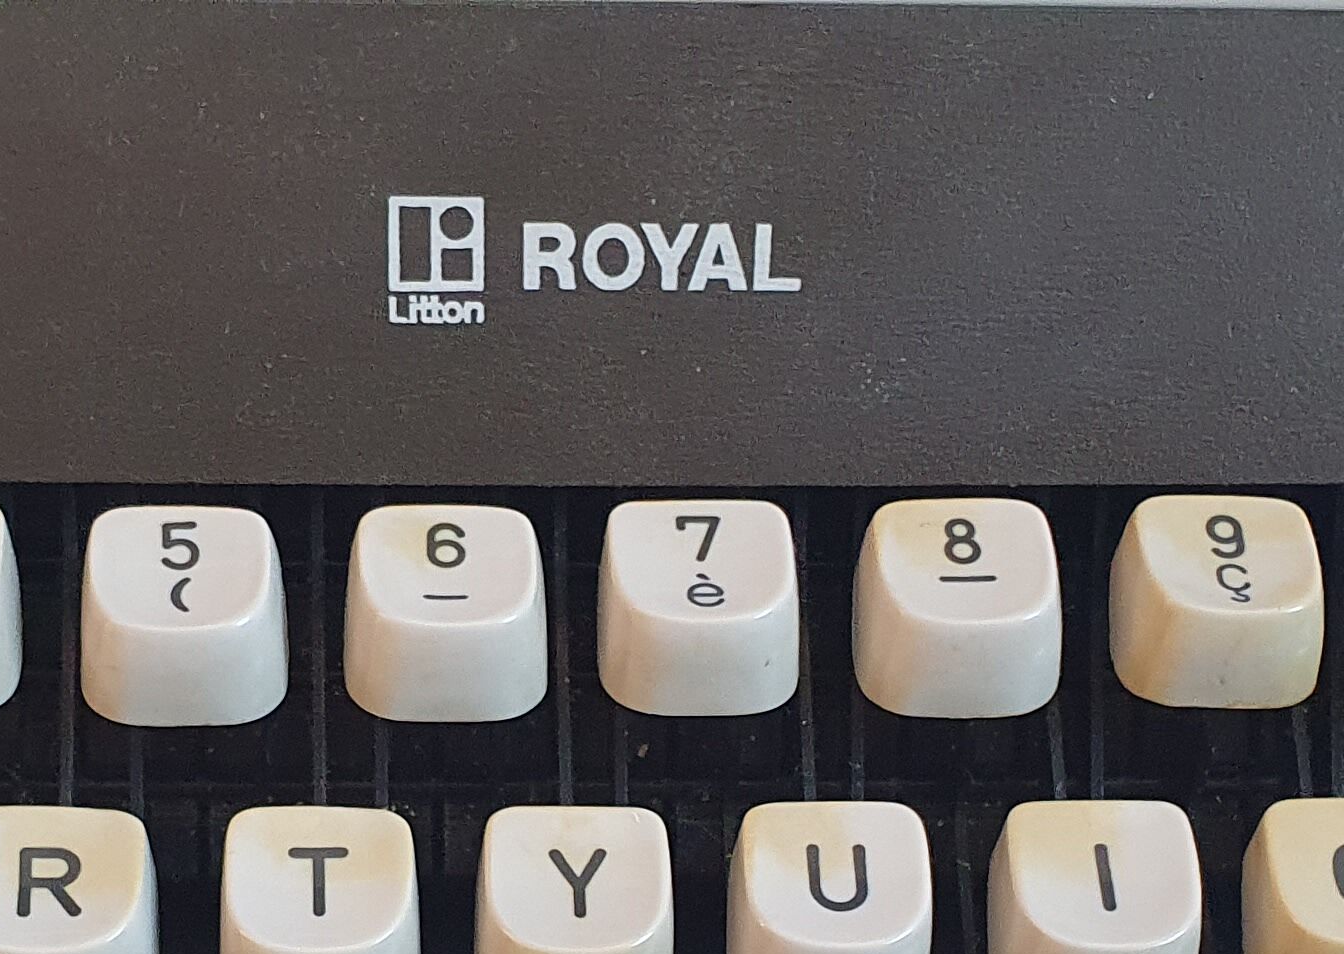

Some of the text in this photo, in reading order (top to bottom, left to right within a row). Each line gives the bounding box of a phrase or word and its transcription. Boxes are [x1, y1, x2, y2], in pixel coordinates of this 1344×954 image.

[522, 222, 802, 292] ROYAL
[388, 294, 486, 325] Litton
[159, 519, 202, 572] 5
[425, 521, 468, 570] 6
[673, 514, 723, 564] 7
[942, 516, 983, 567] 8
[1203, 513, 1247, 561] 9
[168, 575, 193, 614] (
[685, 571, 727, 609] è
[14, 845, 84, 919] R
[286, 845, 351, 919] T
[546, 846, 609, 920] Y
[804, 842, 870, 914] U
[1092, 842, 1119, 913] I
